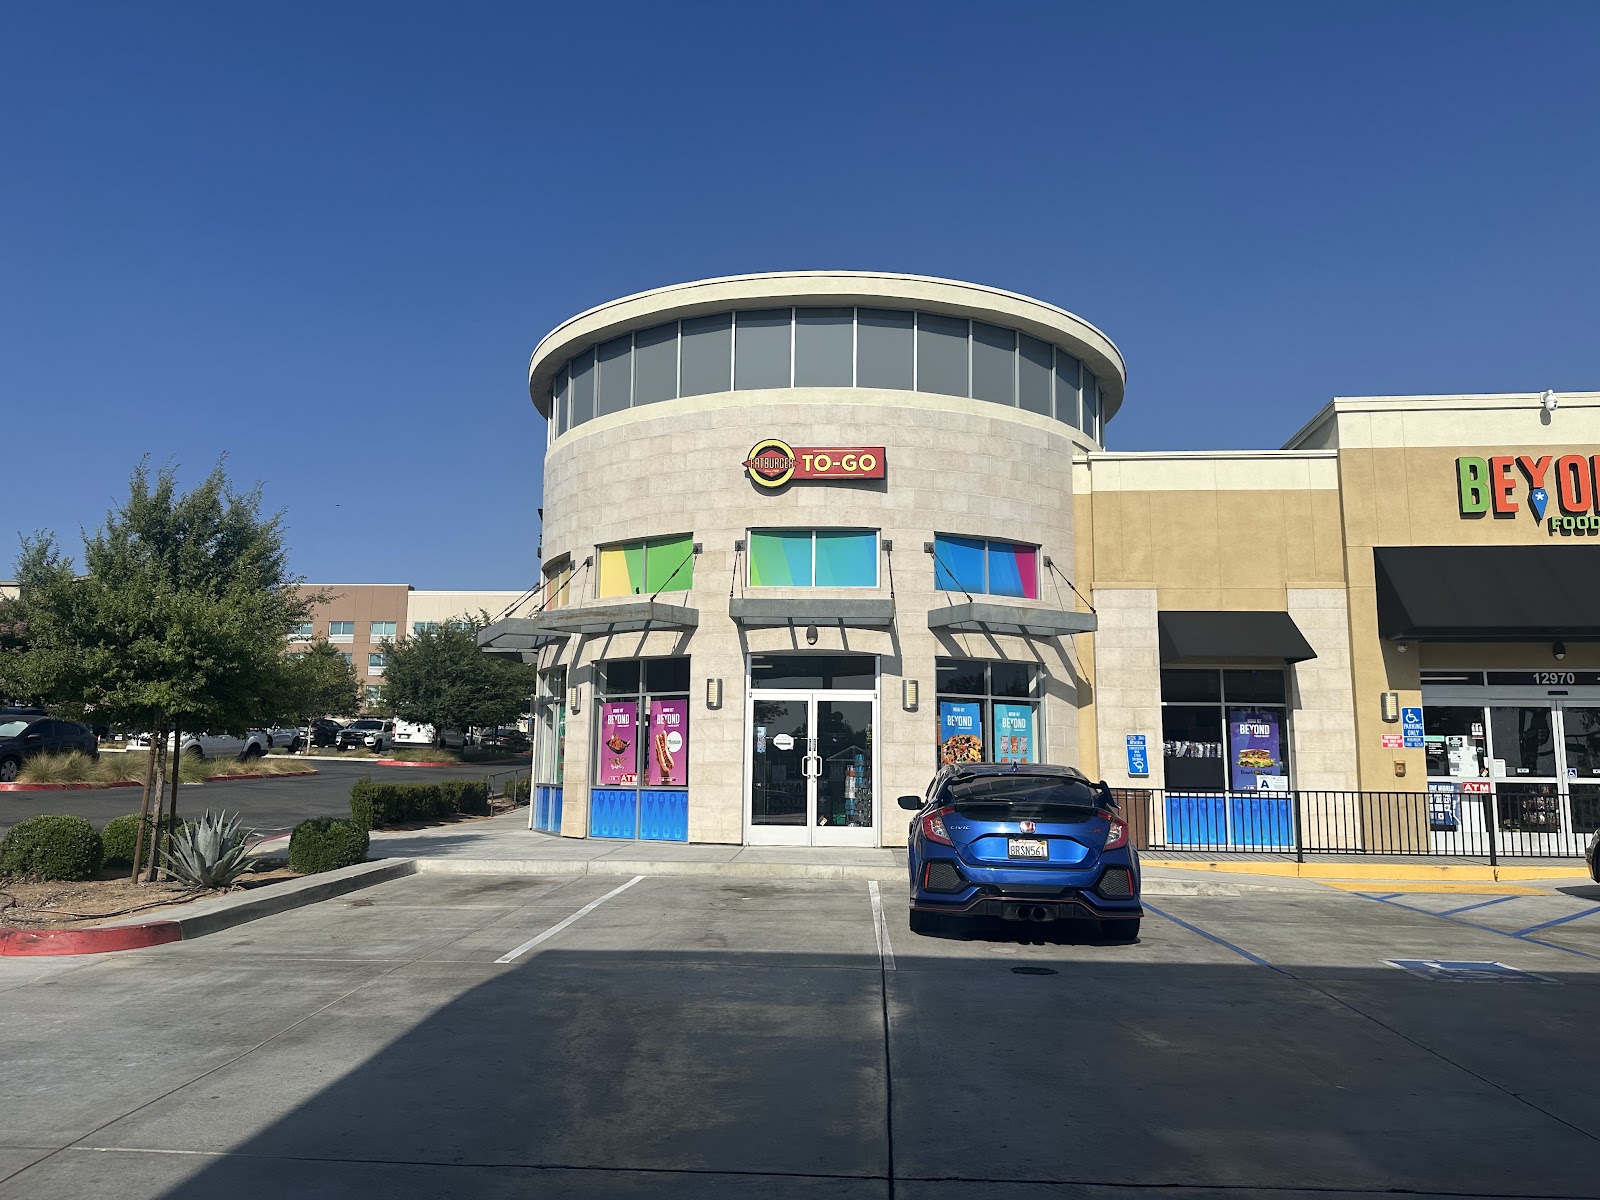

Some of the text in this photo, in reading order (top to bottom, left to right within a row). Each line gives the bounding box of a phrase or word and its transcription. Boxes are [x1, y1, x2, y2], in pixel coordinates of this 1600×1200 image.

[750, 457, 794, 469] FATBURGER
[801, 454, 877, 472] TO-GO
[1456, 454, 1600, 516] BEYO
[1551, 516, 1600, 530] FOOD
[1533, 672, 1575, 684] 12970
[608, 714, 629, 725] BEYOND
[657, 714, 680, 725] BEYOND
[947, 715, 973, 726] BEYOND
[1002, 717, 1026, 728] BEYOND
[1240, 724, 1270, 735] BEYOND
[1261, 780, 1269, 788] A
[1464, 784, 1489, 792] ATM
[1010, 845, 1045, 856] 8RSN561
